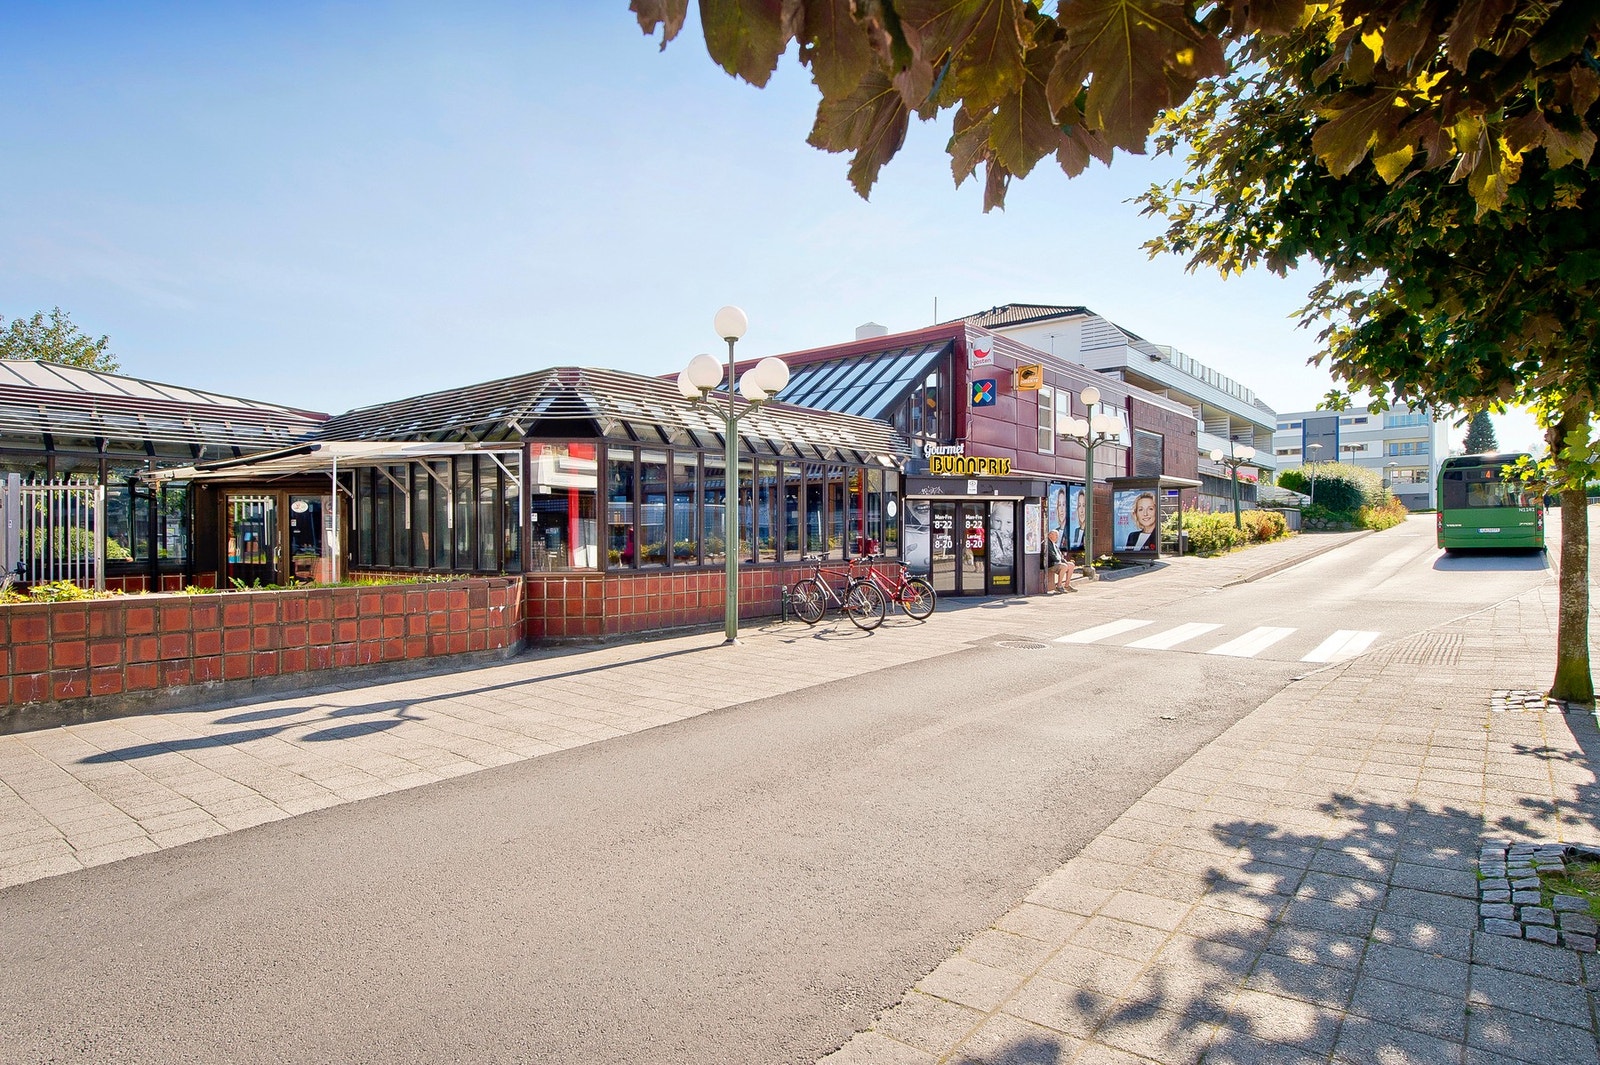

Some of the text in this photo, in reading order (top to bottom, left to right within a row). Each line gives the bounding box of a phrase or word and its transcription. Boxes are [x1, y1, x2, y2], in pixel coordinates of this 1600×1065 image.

[973, 358, 991, 366] posten
[924, 443, 964, 458] Gourmet
[930, 455, 1011, 475] BUNNPRIS
[1485, 470, 1490, 478] 4
[934, 521, 952, 529] 8-22
[965, 521, 983, 529] 8-22
[965, 540, 983, 548] 8-20
